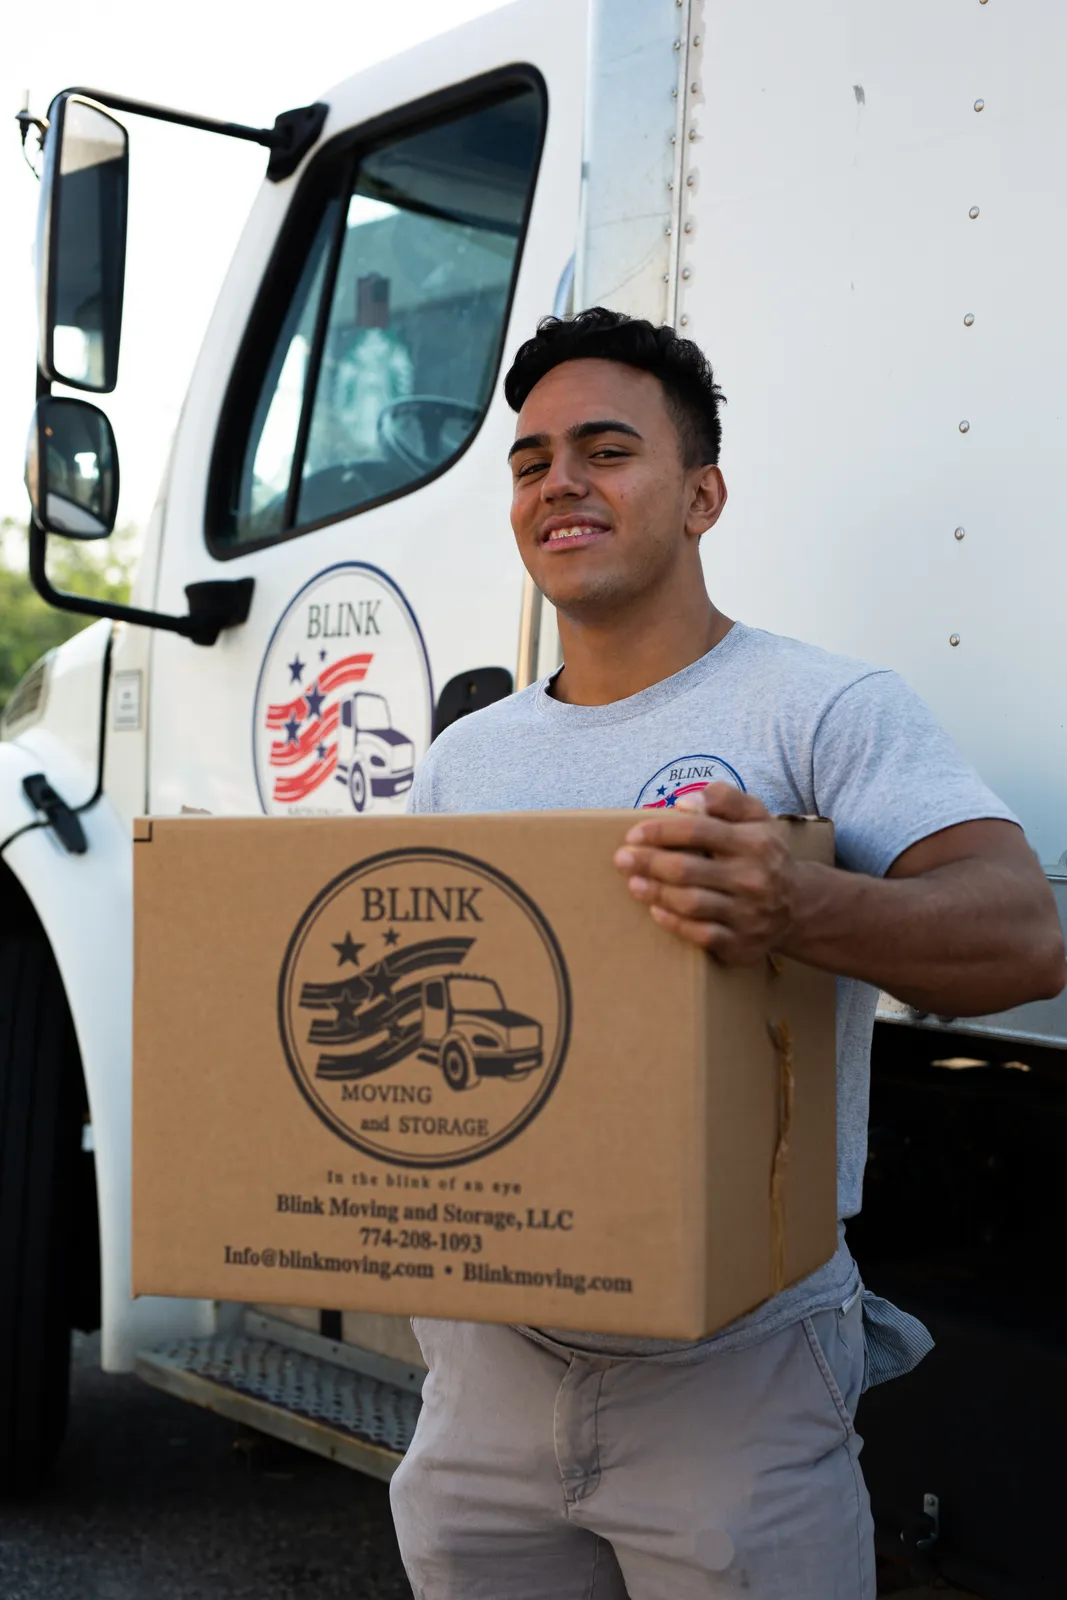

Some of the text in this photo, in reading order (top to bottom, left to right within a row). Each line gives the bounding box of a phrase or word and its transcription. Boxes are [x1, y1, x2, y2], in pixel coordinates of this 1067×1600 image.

[306, 600, 381, 639] BLINK
[669, 766, 715, 781] BLINK
[362, 887, 483, 922] BLINK
[341, 1084, 432, 1104] MOVING
[360, 1115, 489, 1137] and STORAGE
[327, 1170, 522, 1196] In the blink of an eye
[276, 1193, 574, 1231] Blink Moving and Storage, LLC
[359, 1226, 483, 1253] 774-208-1093
[224, 1245, 633, 1294] Info@blinkmoving.com Blinkmoving.com
